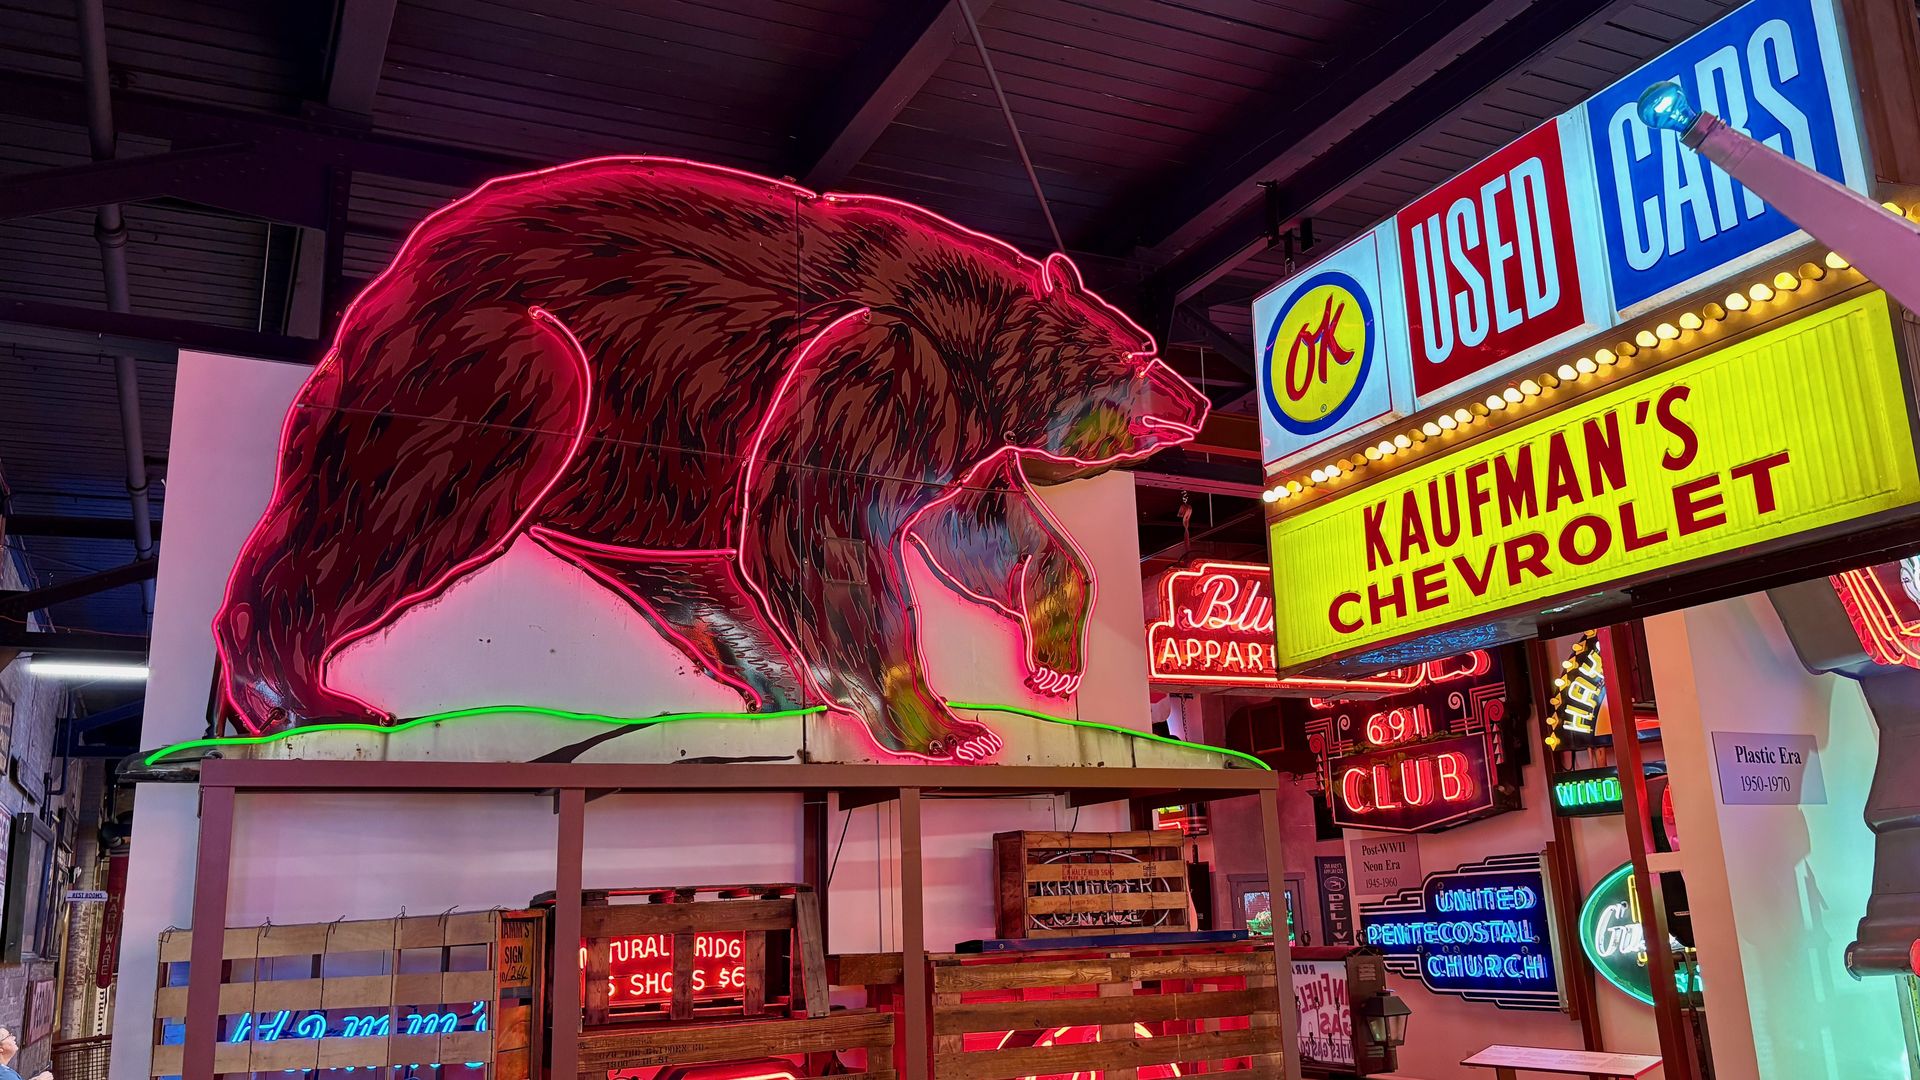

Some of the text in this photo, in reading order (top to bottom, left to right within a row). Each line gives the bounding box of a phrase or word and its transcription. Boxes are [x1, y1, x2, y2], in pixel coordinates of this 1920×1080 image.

[1411, 19, 1816, 364] USED CARS
[1286, 292, 1354, 401] OK
[1364, 386, 1698, 571] KAUFMAN'S
[1328, 451, 1790, 634] CHEVROLET
[1184, 574, 1274, 632] Blu
[1157, 637, 1276, 671] APPAR
[1367, 706, 1428, 745] 691
[1735, 745, 1802, 765] Plastic Era
[1343, 751, 1474, 814] CLUB
[1741, 775, 1791, 792] 1950-1970
[1361, 841, 1406, 856] Post-WWII
[1363, 859, 1401, 872] Neon Era
[1365, 877, 1398, 889] 1945-1960
[1435, 886, 1537, 912] UNITED
[101, 892, 121, 976] HARDWARE
[1367, 919, 1536, 945] PENTECOSTAL
[504, 945, 523, 964] SIGN
[694, 936, 742, 959] RIDG
[1427, 953, 1548, 980] CHURCH
[629, 969, 706, 996] SHOS
